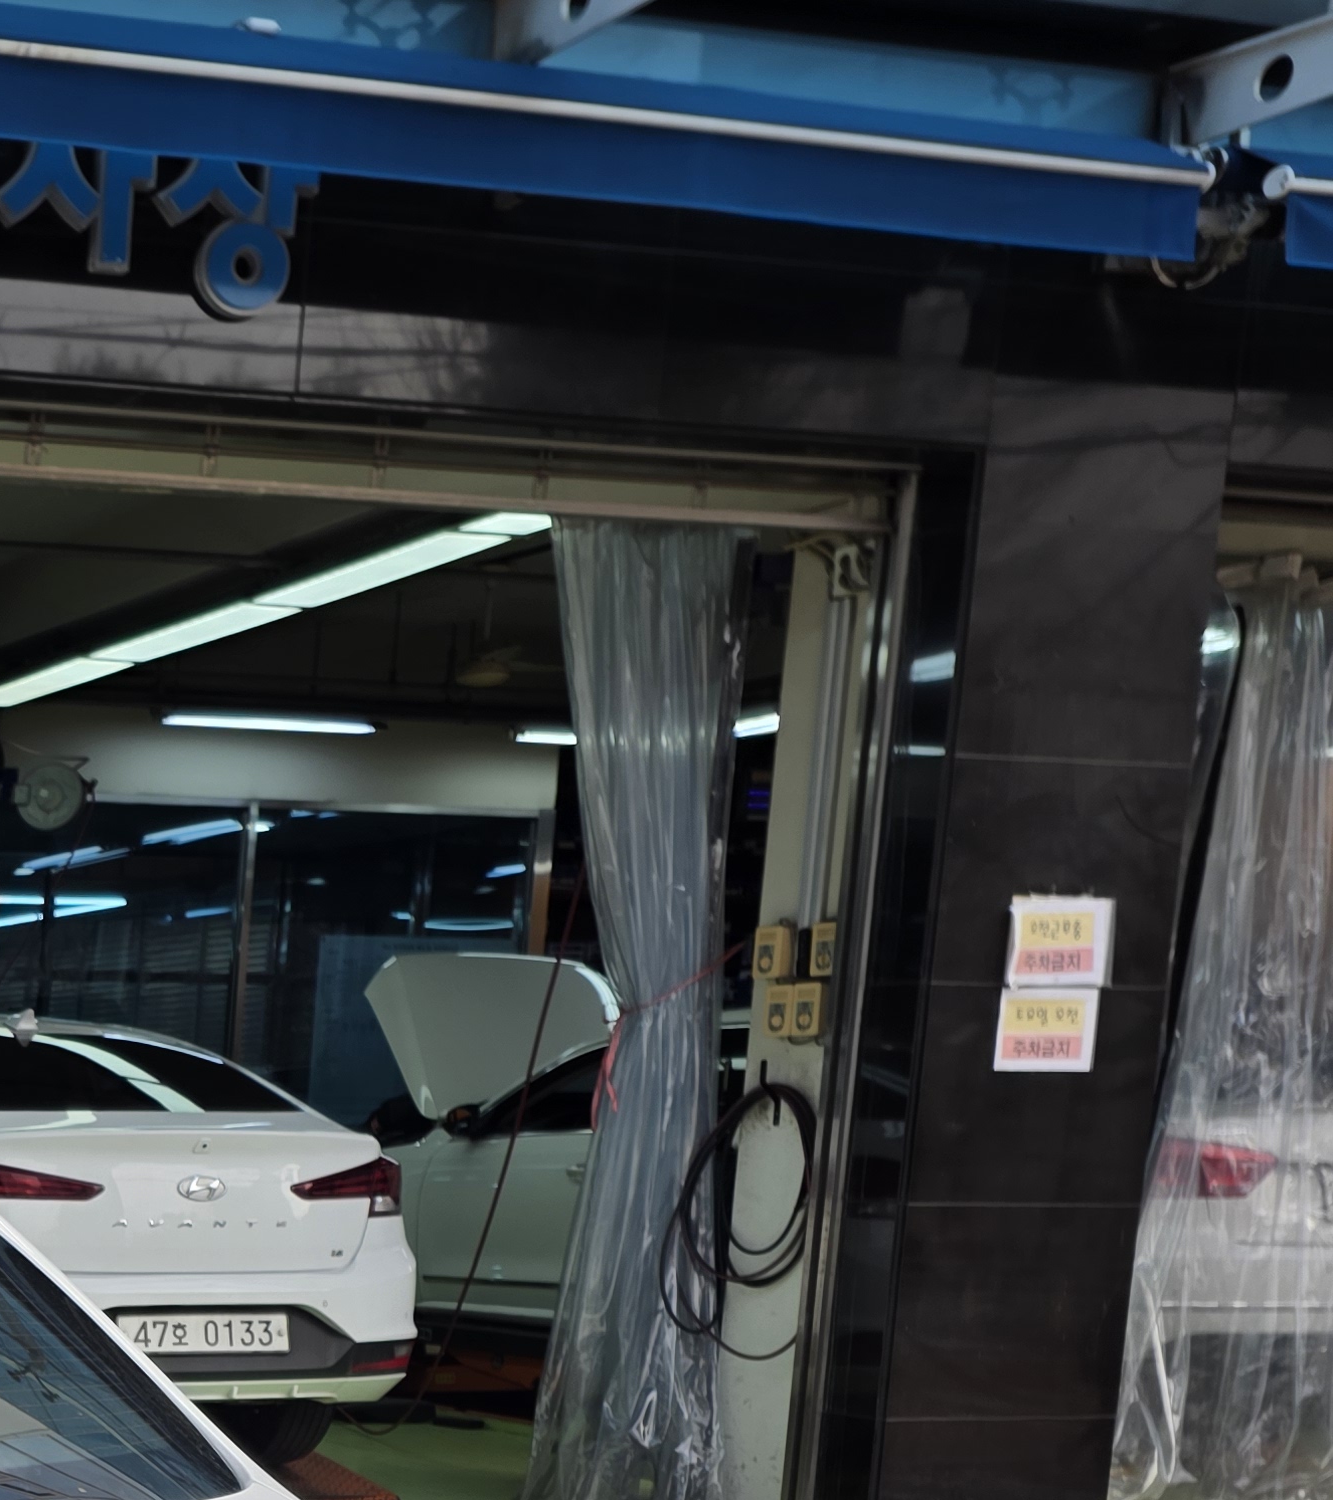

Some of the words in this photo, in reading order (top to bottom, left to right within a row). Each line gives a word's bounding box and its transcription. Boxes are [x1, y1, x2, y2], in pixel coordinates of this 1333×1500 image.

[1023, 952, 1082, 973] 주차금지
[1012, 1038, 1071, 1059] 주차금지
[133, 1320, 189, 1348] 47호
[203, 1319, 274, 1348] 0133
